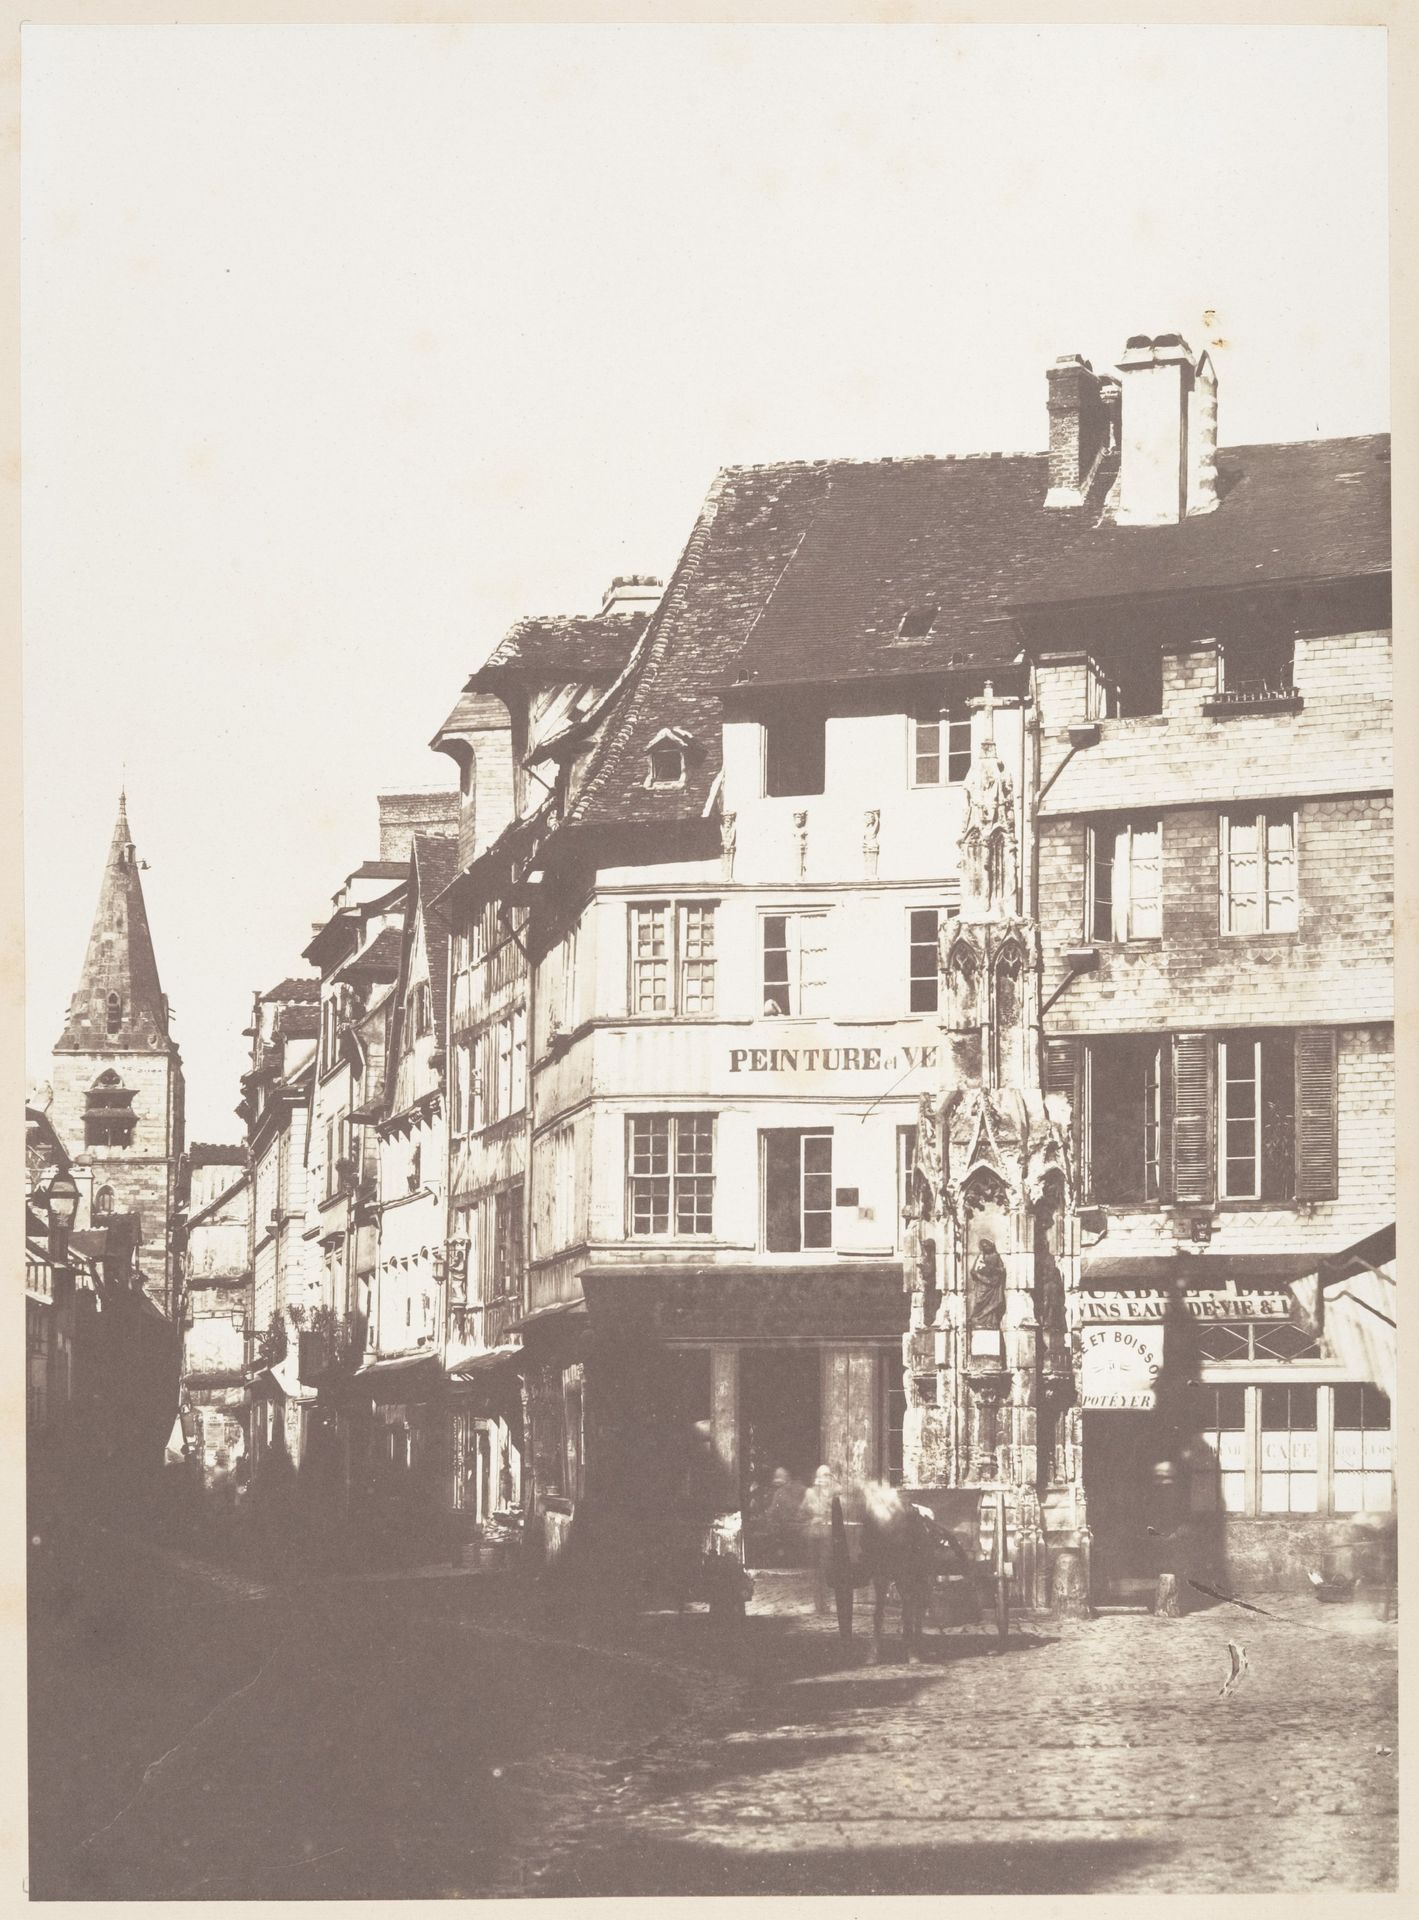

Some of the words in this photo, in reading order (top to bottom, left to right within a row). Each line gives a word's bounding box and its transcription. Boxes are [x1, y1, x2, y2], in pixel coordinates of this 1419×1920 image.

[729, 1048, 881, 1072] PEINTURE
[884, 1056, 897, 1070] et
[1127, 1302, 1171, 1317] EAU
[1089, 1331, 1106, 1347] ET
